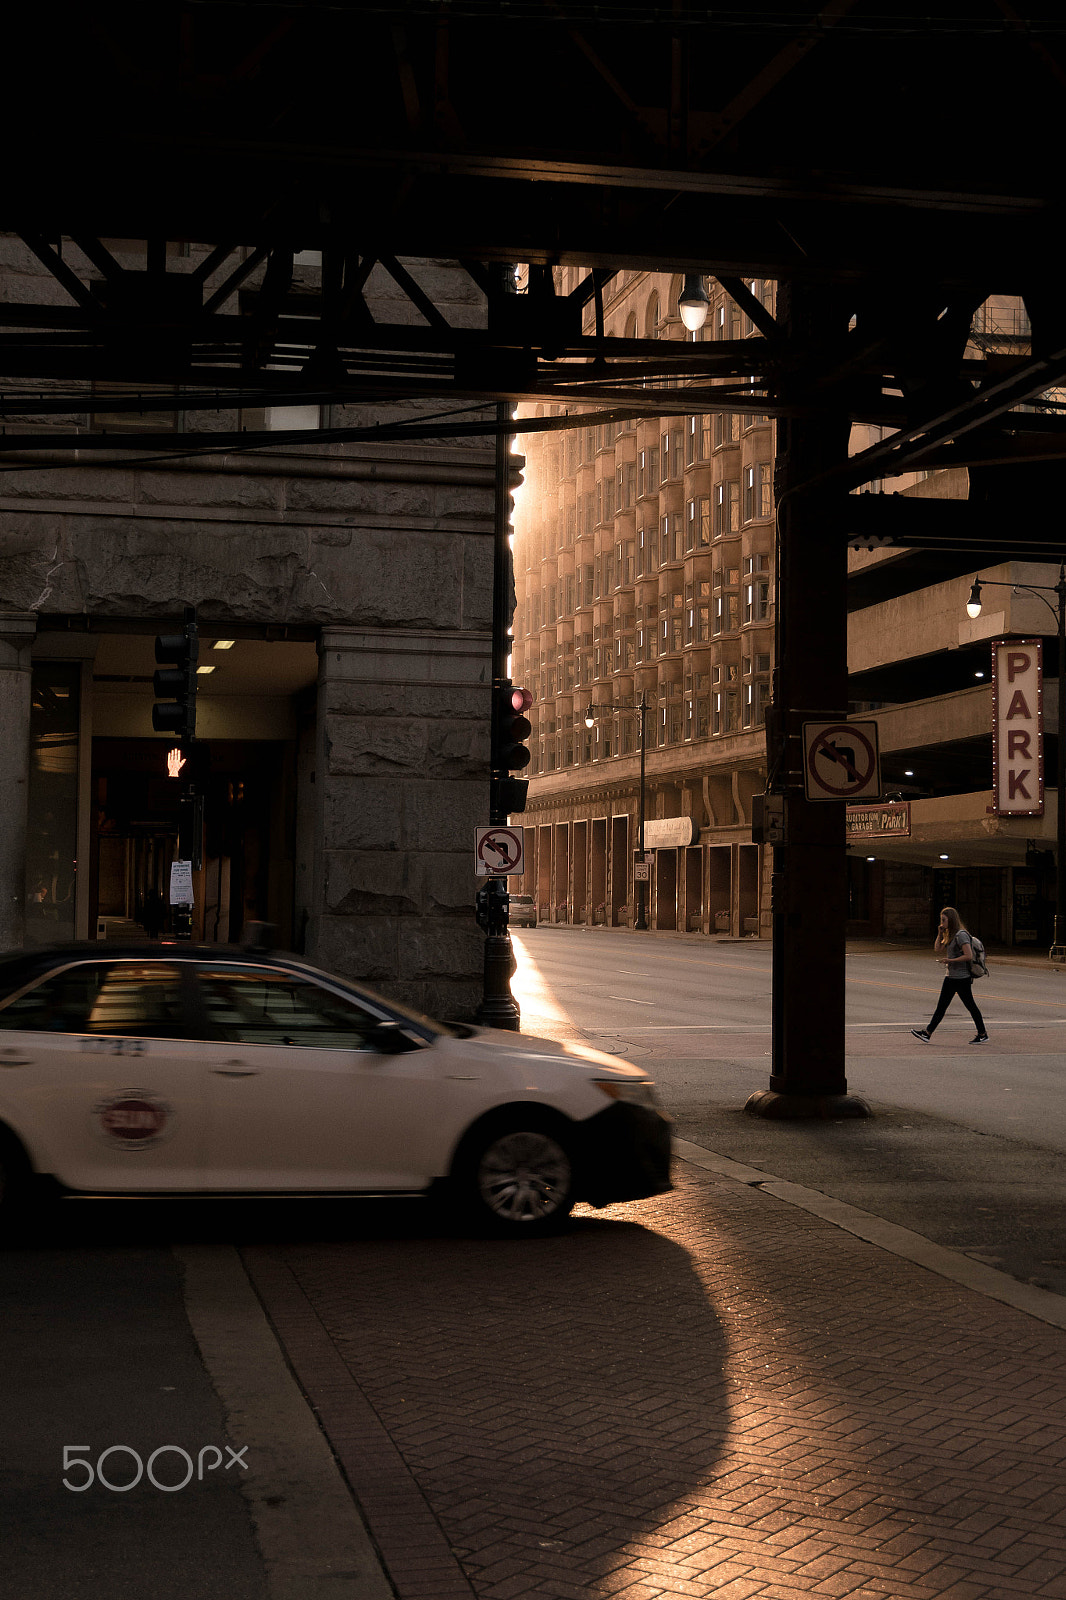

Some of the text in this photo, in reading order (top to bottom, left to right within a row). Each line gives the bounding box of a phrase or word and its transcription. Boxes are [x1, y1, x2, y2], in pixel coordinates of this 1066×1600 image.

[1006, 652, 1032, 800] PARK
[851, 822, 873, 831] GARAGE
[881, 812, 902, 829] PARK
[636, 871, 648, 879] 30
